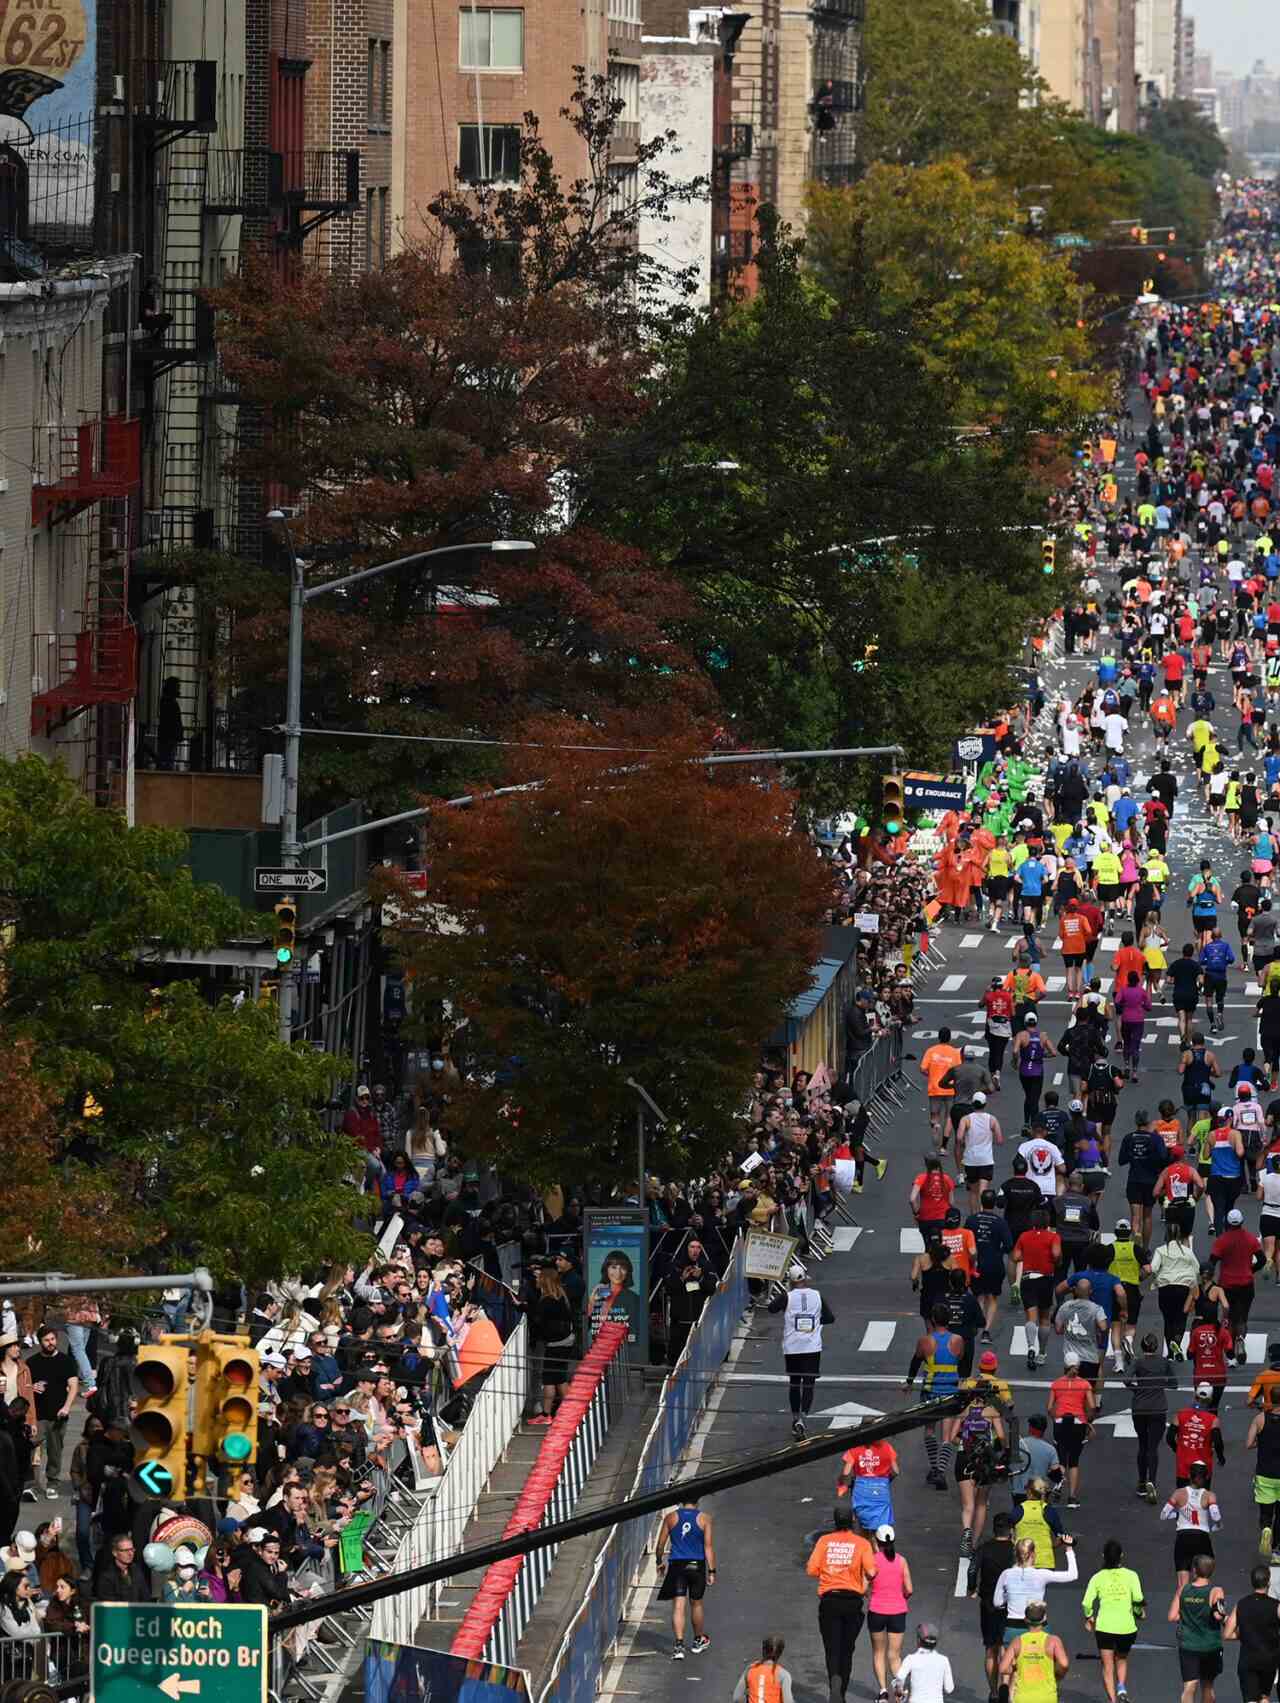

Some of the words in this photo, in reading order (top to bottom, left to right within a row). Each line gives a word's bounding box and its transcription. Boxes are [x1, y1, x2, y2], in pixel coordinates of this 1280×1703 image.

[5, 14, 66, 66] 62
[24, 150, 89, 161] LERY.COM
[924, 789, 962, 799] ENDURANCE
[261, 874, 281, 886] ONE
[294, 875, 317, 886] WAY
[135, 1616, 160, 1638] Ed
[170, 1616, 223, 1639] Koch
[97, 1643, 230, 1667] Queensboro
[237, 1645, 260, 1668] Br
